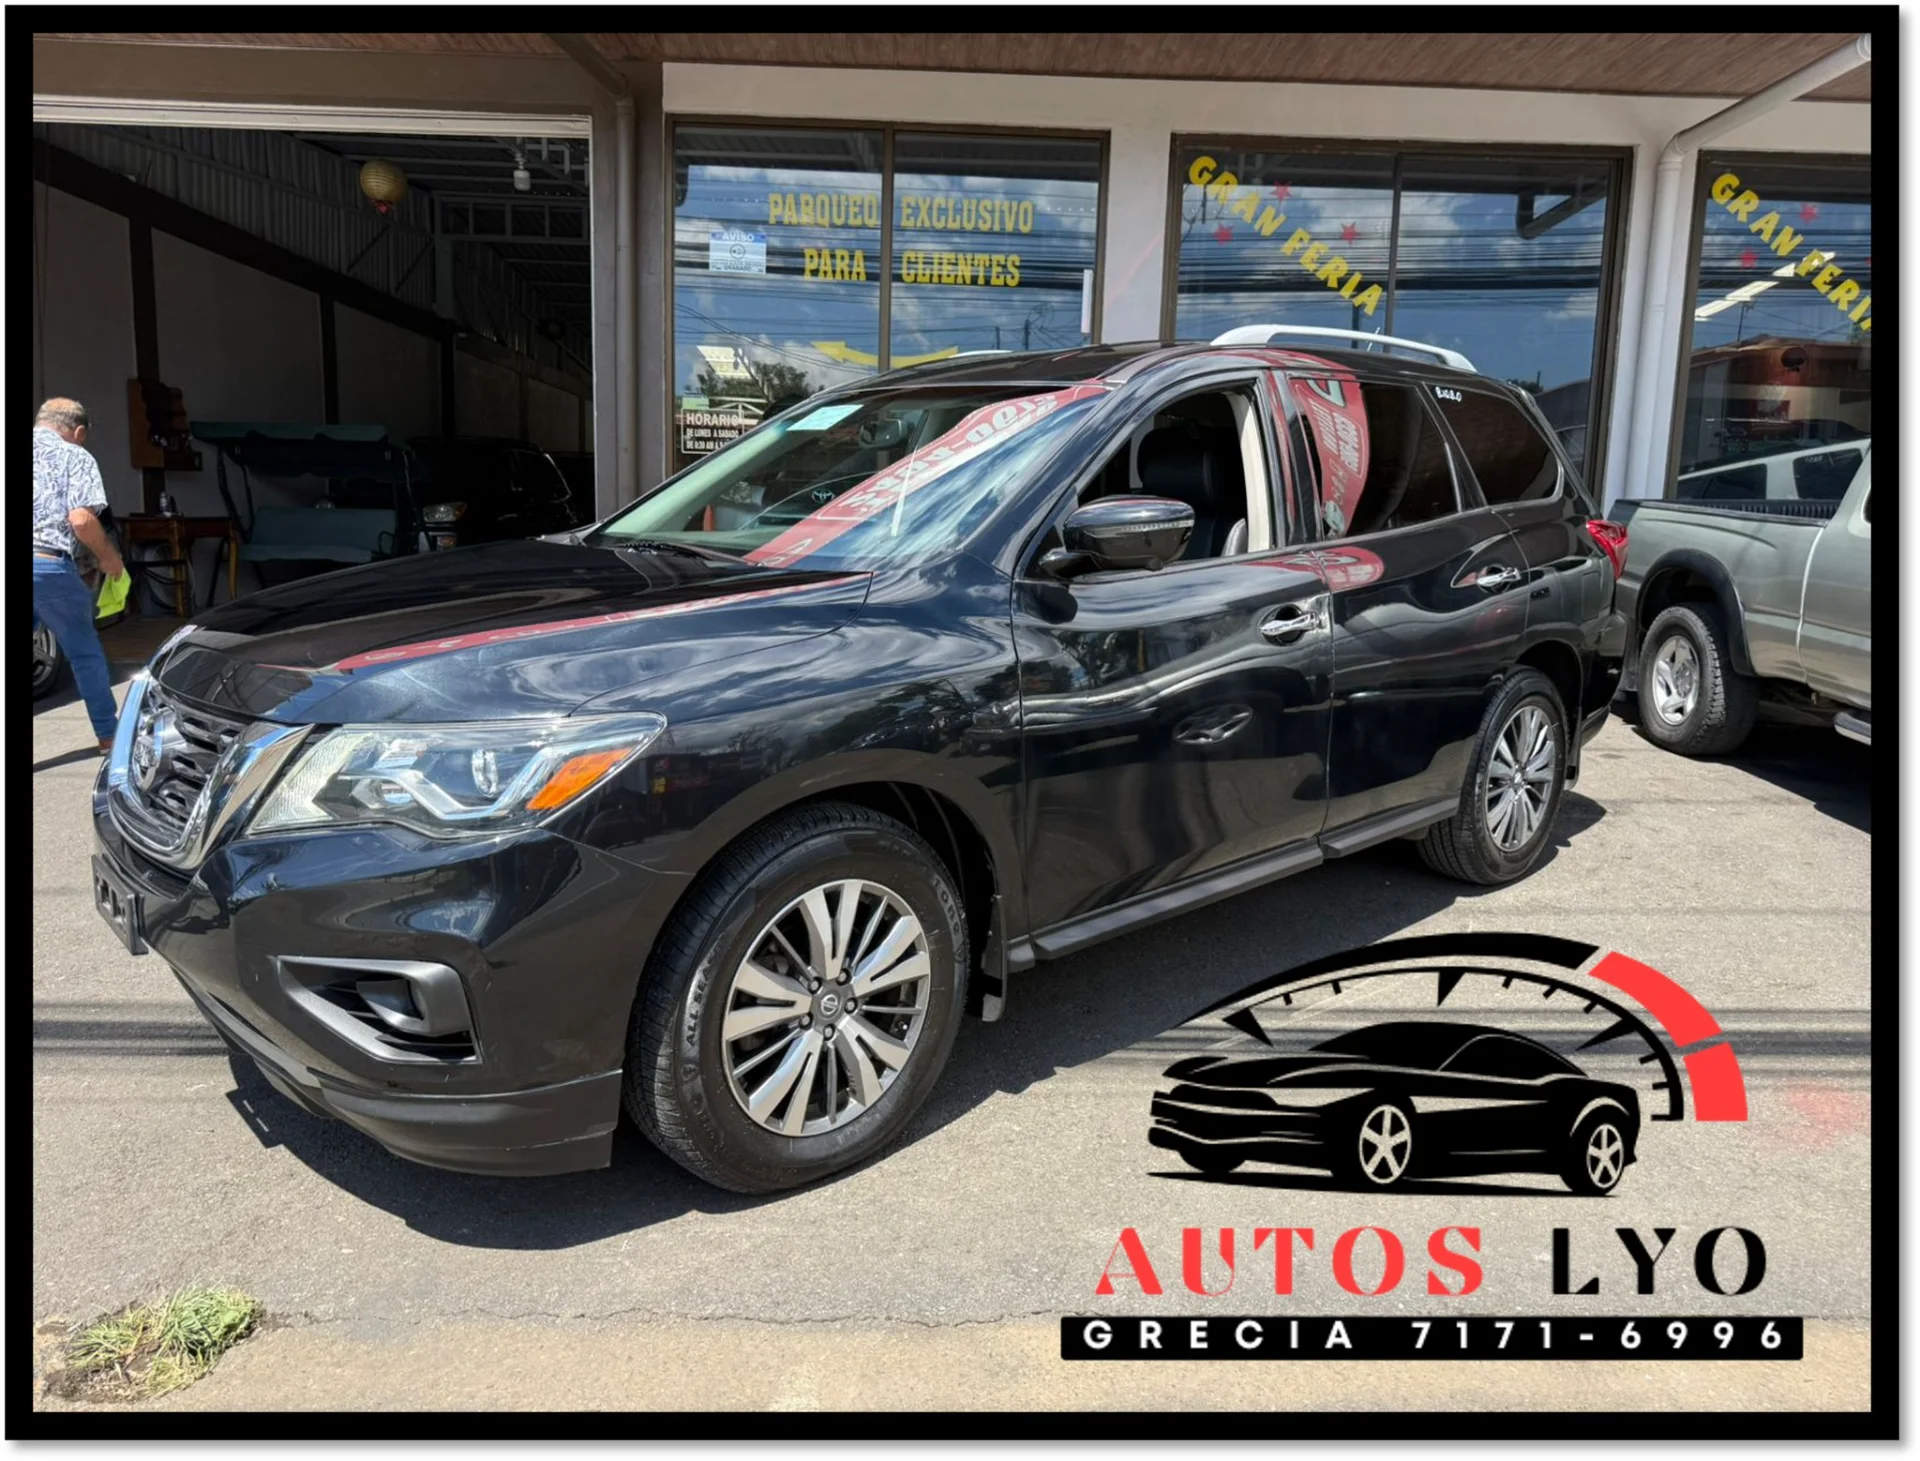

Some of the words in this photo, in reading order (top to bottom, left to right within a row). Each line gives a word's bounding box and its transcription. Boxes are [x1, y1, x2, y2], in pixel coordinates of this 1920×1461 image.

[768, 193, 879, 228] PARQUEO
[901, 199, 1034, 234] EXCLUSIVO
[1711, 173, 1804, 257] GRAN
[722, 230, 755, 242] AVISO
[1188, 156, 1284, 237] GRAN
[1280, 229, 1384, 316] FERIA
[804, 249, 867, 282] PARA
[901, 250, 1021, 287] CLIENTES
[686, 413, 739, 426] HORARIO
[686, 428, 694, 437] DE
[686, 1010, 699, 1046] ALL
